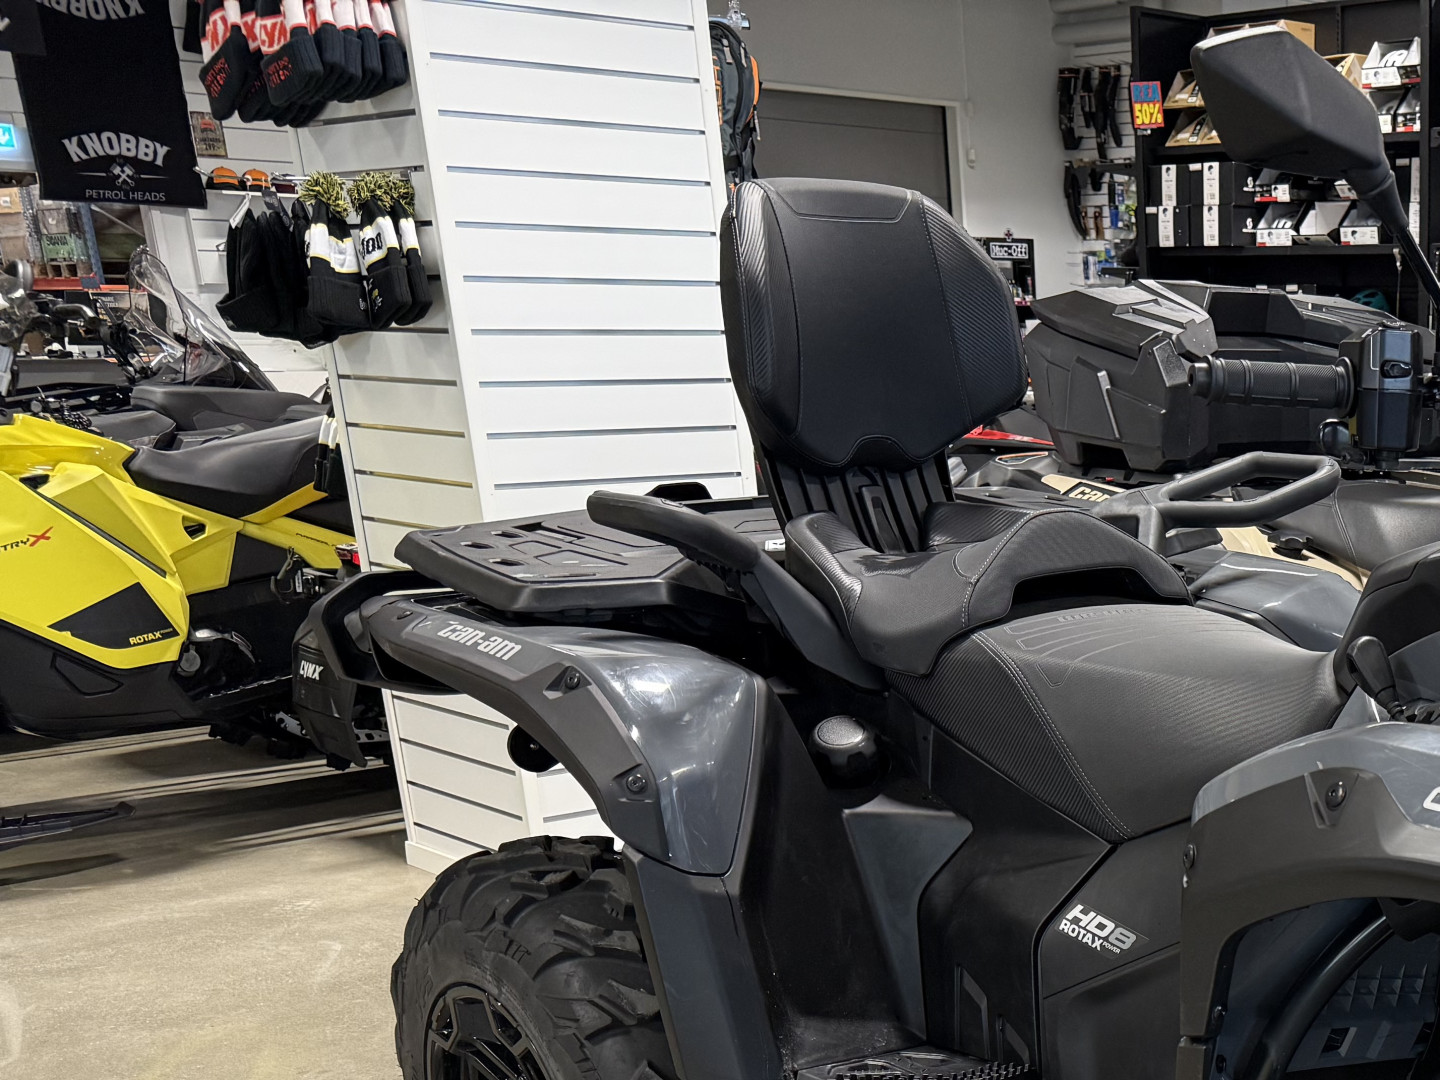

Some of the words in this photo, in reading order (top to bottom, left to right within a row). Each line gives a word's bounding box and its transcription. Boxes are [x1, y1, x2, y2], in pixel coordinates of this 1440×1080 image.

[1132, 84, 1160, 102] REA
[1135, 103, 1162, 125] 50%
[61, 131, 171, 167] KNOBBY
[85, 189, 126, 200] PETROL
[129, 191, 166, 202] HEADS
[129, 631, 162, 646] ROTAX
[437, 620, 522, 661] can-am
[300, 659, 324, 681] LYNX
[1058, 919, 1103, 951] ROTAX
[1102, 941, 1121, 954] POWER
[1065, 904, 1137, 950] HD8
